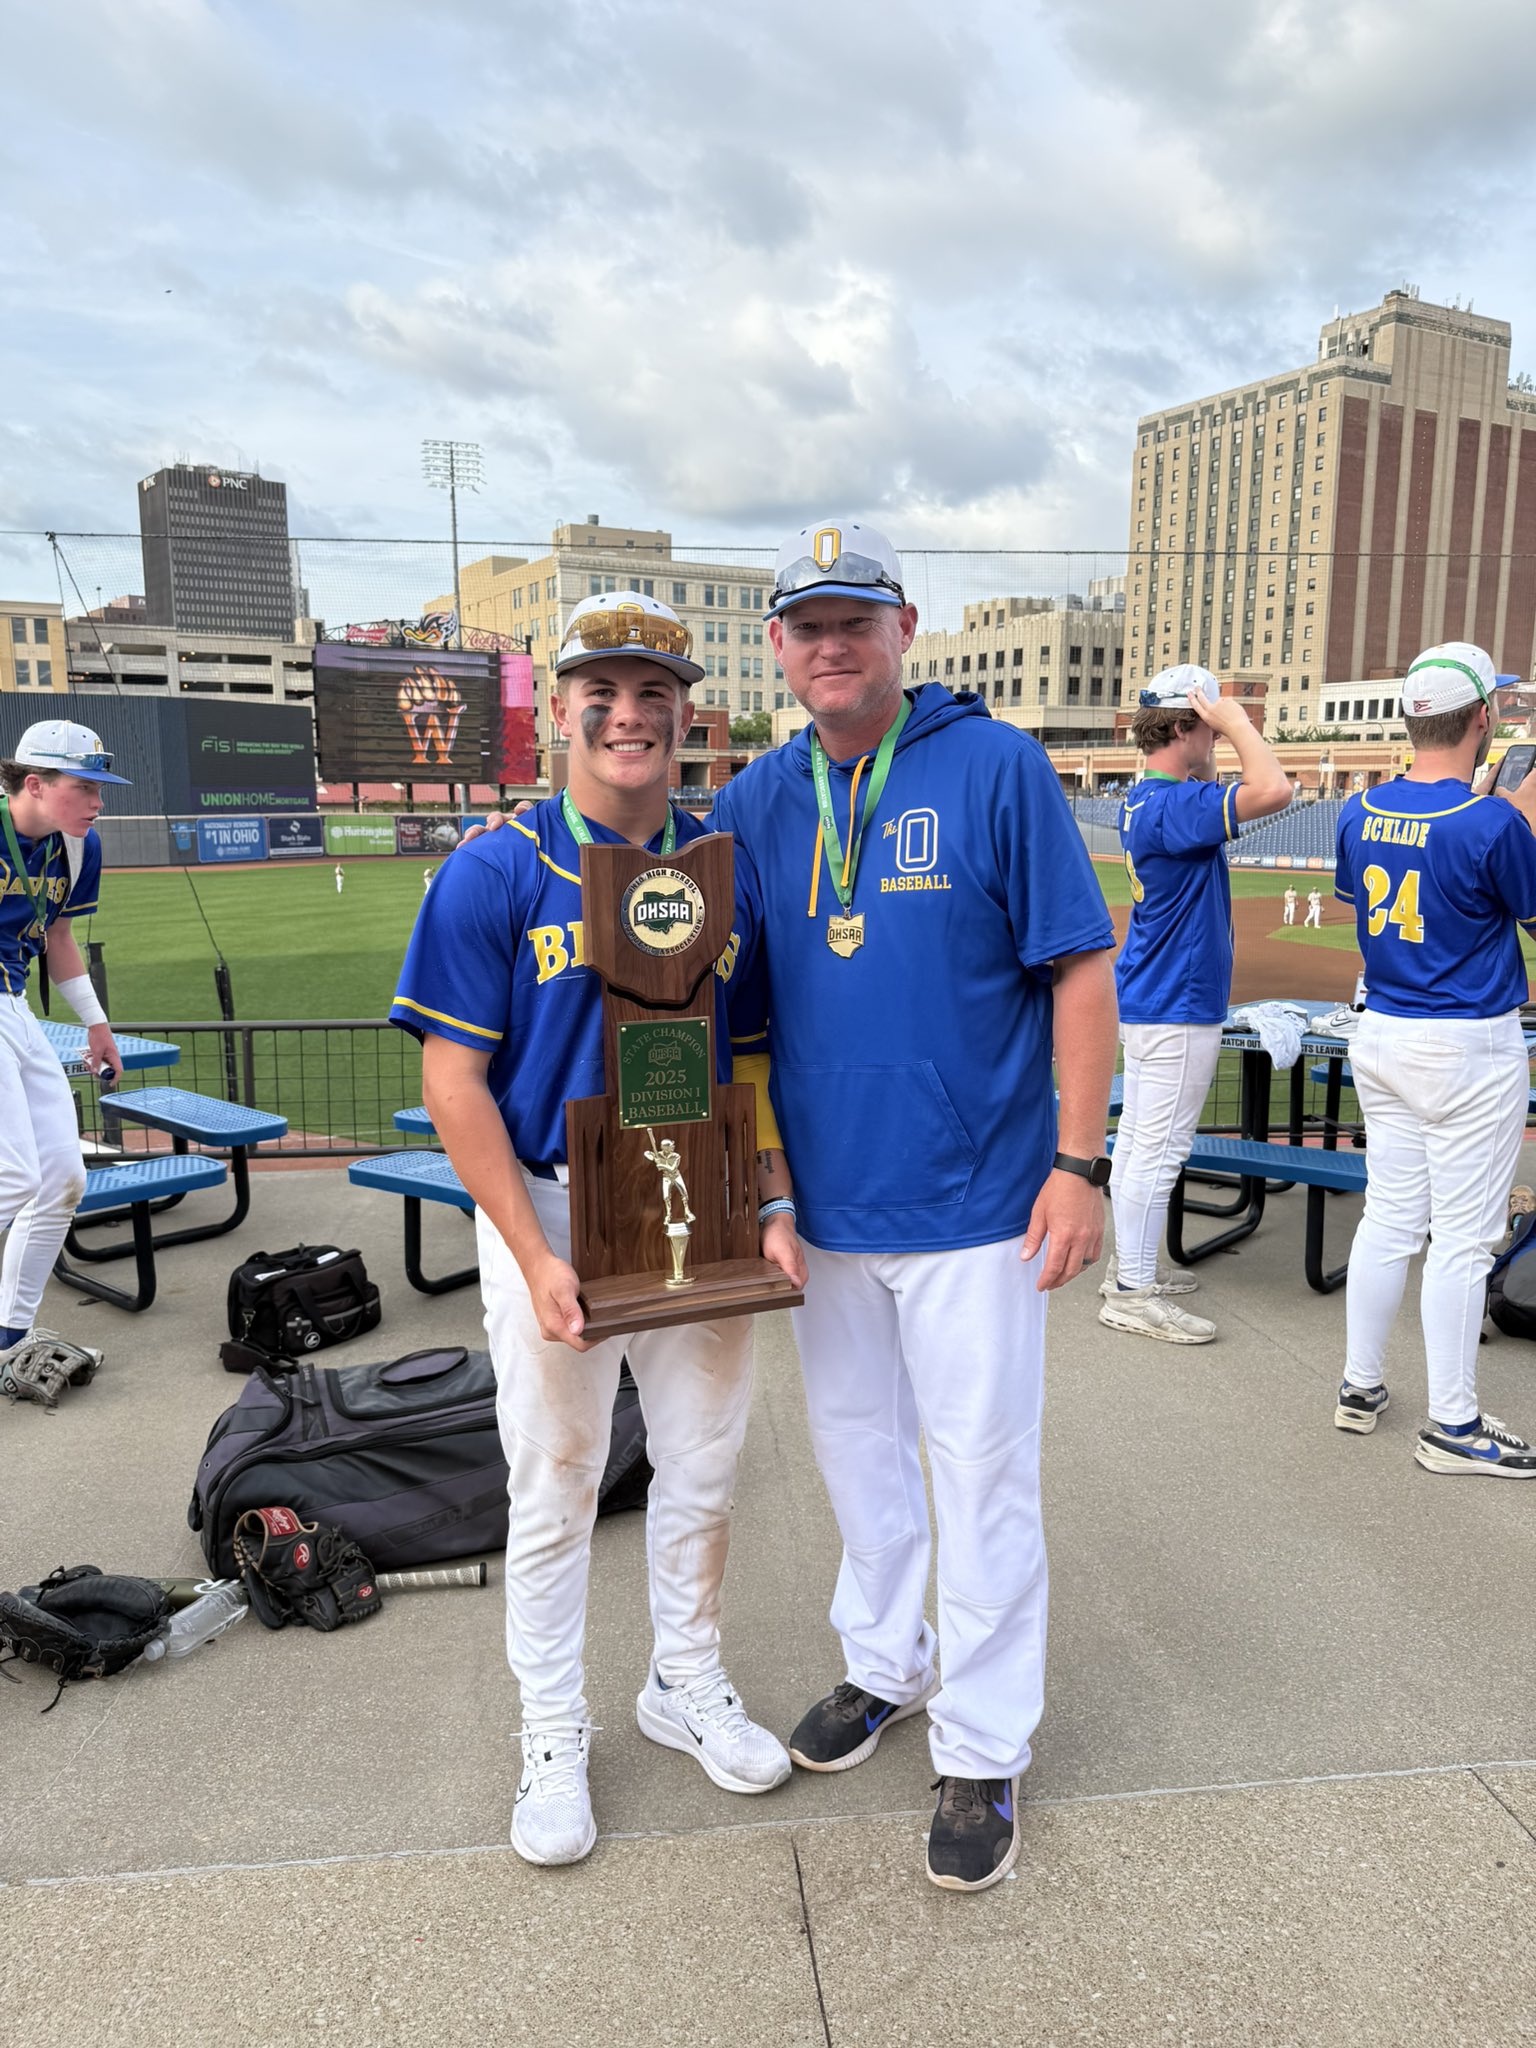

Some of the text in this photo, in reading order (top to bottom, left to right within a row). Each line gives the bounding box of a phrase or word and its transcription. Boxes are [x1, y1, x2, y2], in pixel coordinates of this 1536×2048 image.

[223, 477, 247, 490] PNC
[201, 740, 231, 753] FIS
[219, 829, 231, 844] IN
[232, 828, 260, 844] OHIO
[882, 817, 898, 840] The
[1361, 815, 1431, 848] SCHLADE
[896, 807, 939, 873] O
[646, 869, 667, 880] HIGH
[670, 870, 698, 894] SCHOOL
[880, 874, 952, 893] BASEBALL
[637, 901, 689, 922] OHSAA
[1363, 864, 1424, 943] 24
[659, 917, 703, 955] ASSOCIATION
[829, 927, 862, 942] OHSAA
[623, 1027, 706, 1065] STATE CHAMPION
[1246, 1039, 1261, 1049] OUT
[1316, 1045, 1348, 1056] LEAVING
[644, 1069, 687, 1086] 2025
[631, 1087, 693, 1103] DIVISION
[628, 1102, 704, 1119] BASEBALL
